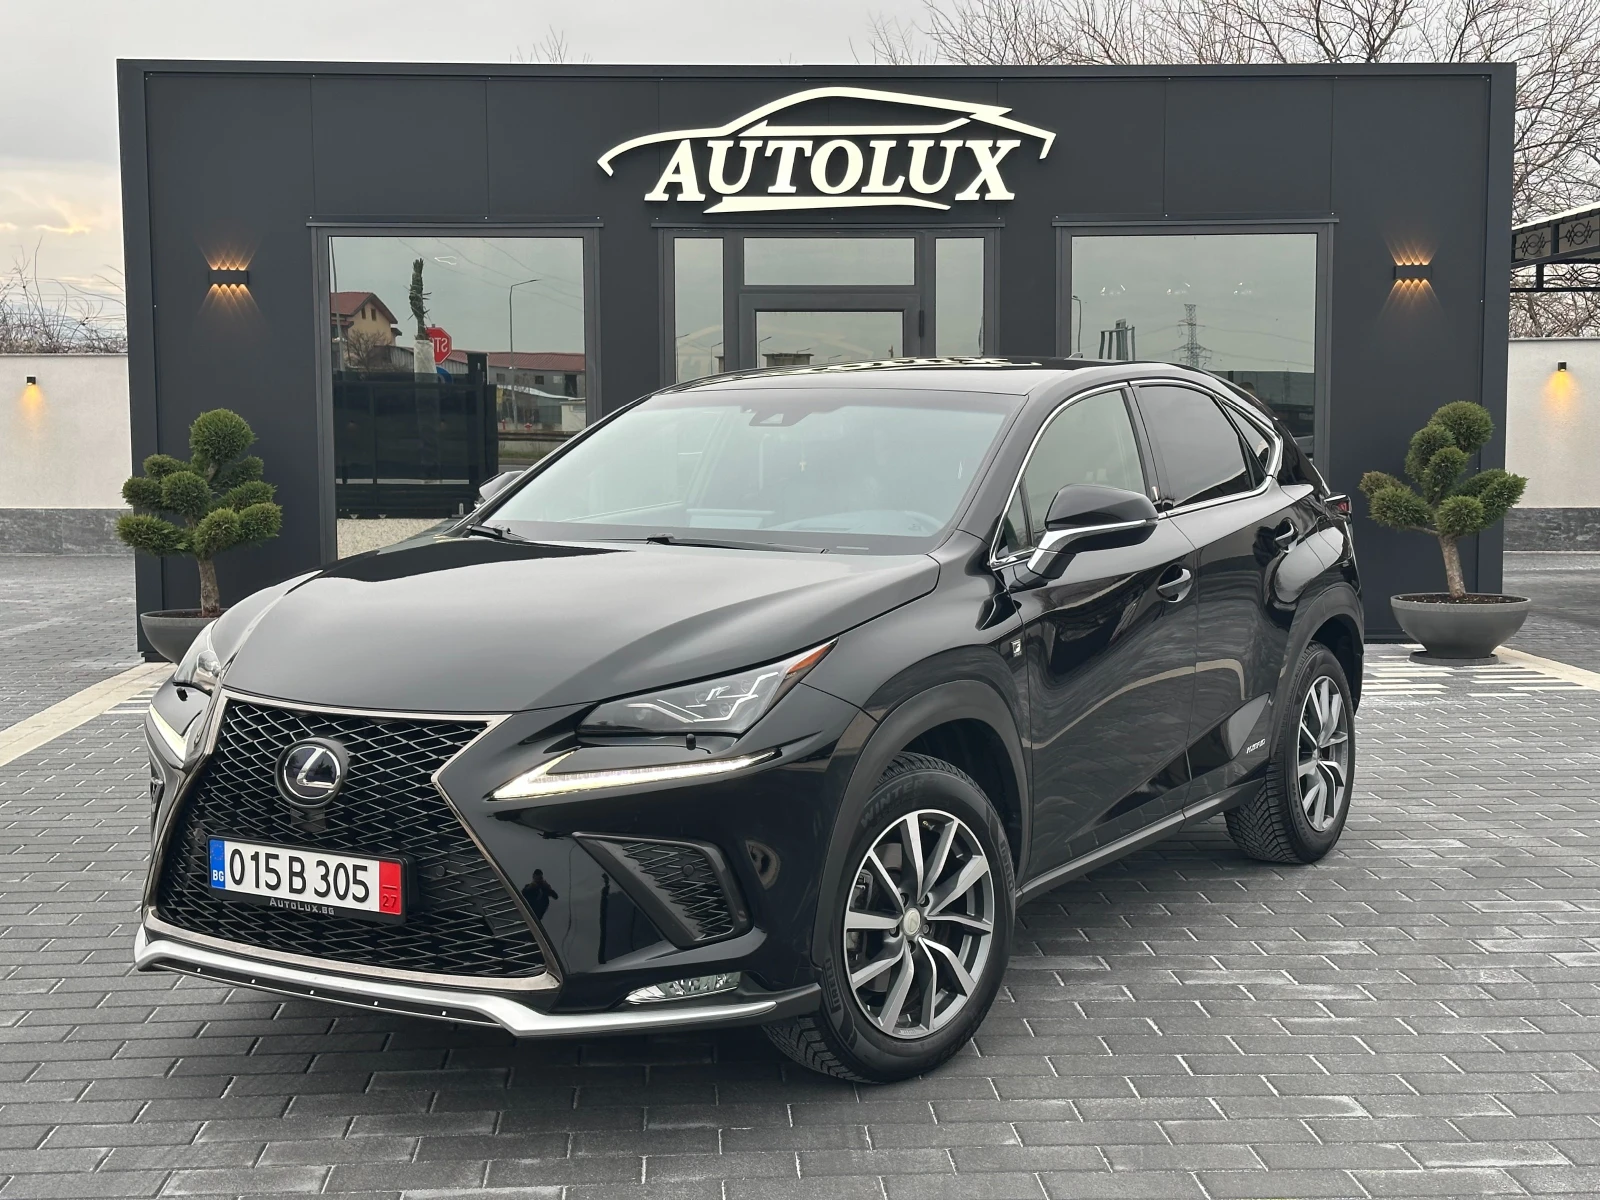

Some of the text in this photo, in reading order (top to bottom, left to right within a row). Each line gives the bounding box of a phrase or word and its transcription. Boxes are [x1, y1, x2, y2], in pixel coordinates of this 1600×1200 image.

[643, 139, 1021, 202] AUTOLUX
[212, 869, 225, 882] BG
[382, 893, 398, 908] 27
